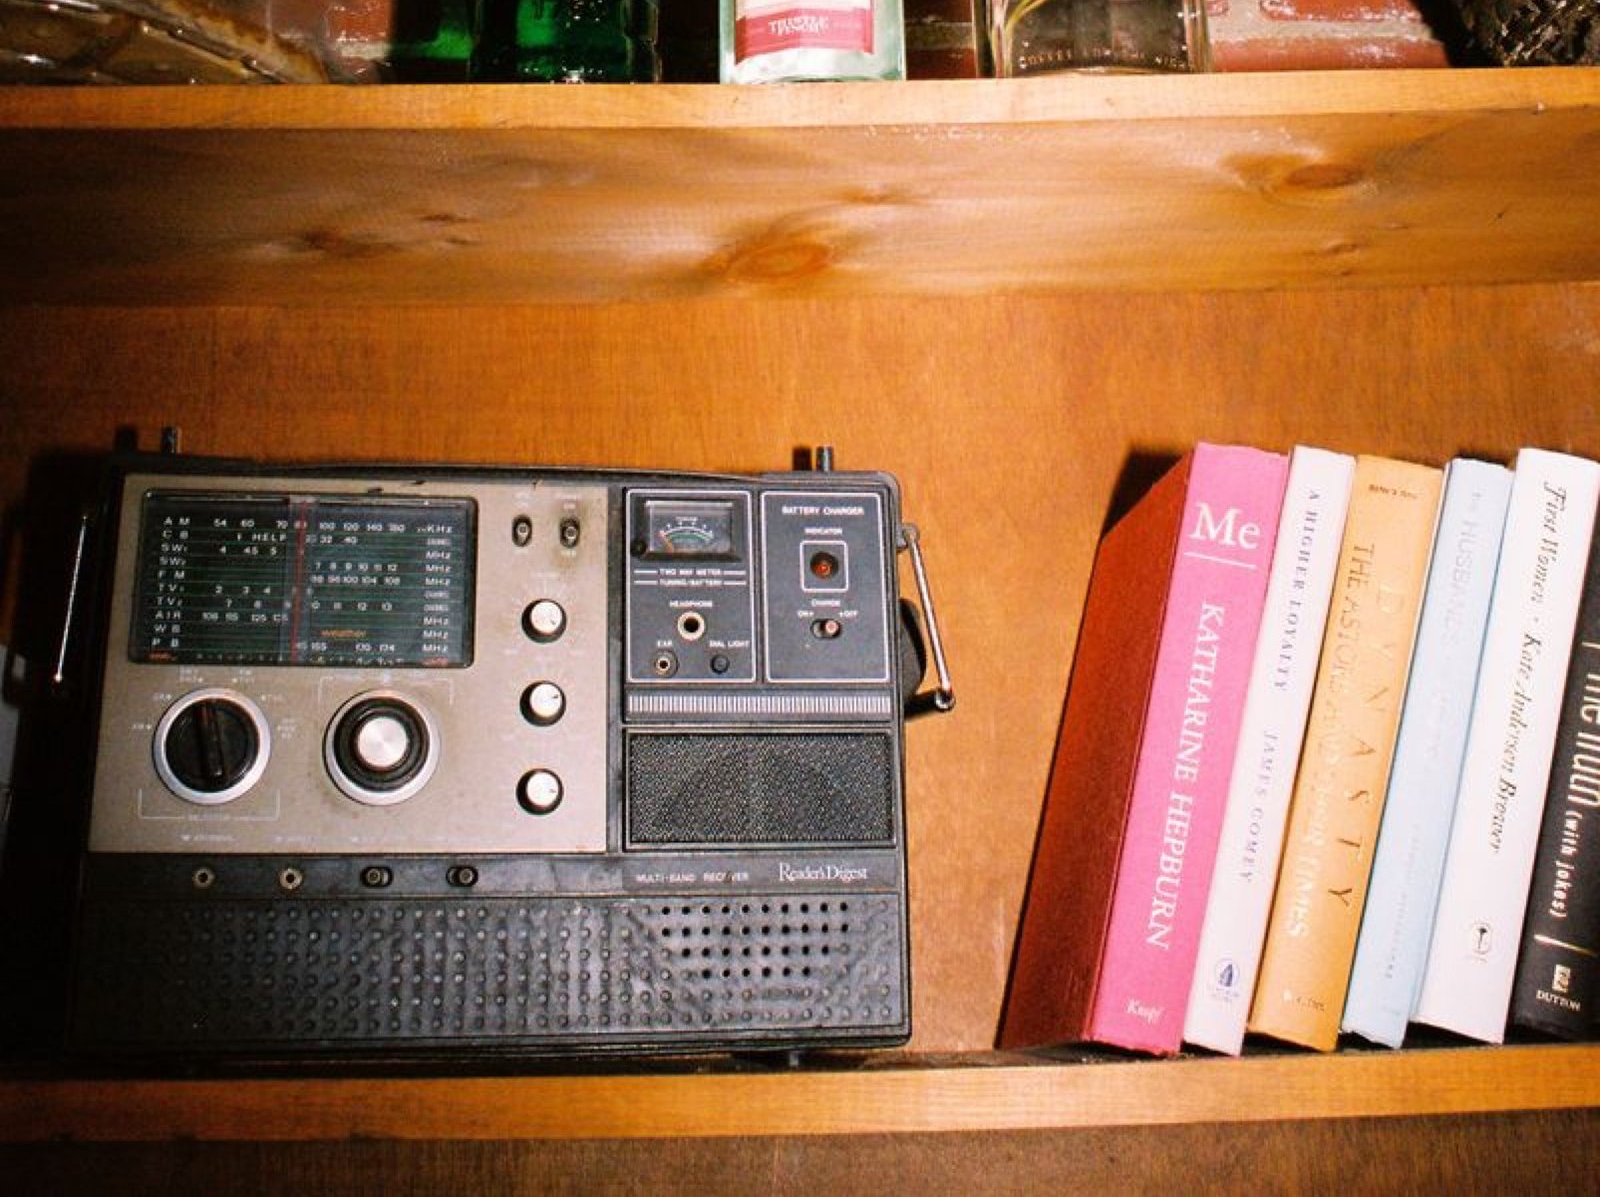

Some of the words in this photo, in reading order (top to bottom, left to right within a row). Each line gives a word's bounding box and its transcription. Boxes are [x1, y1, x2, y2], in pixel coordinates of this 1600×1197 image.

[781, 506, 820, 515] BATTERY
[823, 506, 865, 515] CHARGER
[1308, 489, 1320, 500] A
[1543, 480, 1567, 534] First
[1189, 502, 1261, 550] Me
[1294, 510, 1318, 590] HIGHER
[1531, 537, 1560, 604] Women
[1274, 600, 1302, 692] LOYALTY
[1518, 632, 1542, 681] Kate
[1174, 601, 1226, 783] KATHARINE
[1254, 730, 1279, 797] JAMES
[1146, 790, 1194, 951] HEPBURN
[1239, 807, 1265, 882] COMEY
[703, 871, 749, 883] RECVER
[826, 864, 868, 883] Digest
[1536, 987, 1582, 1012] DUTTON
